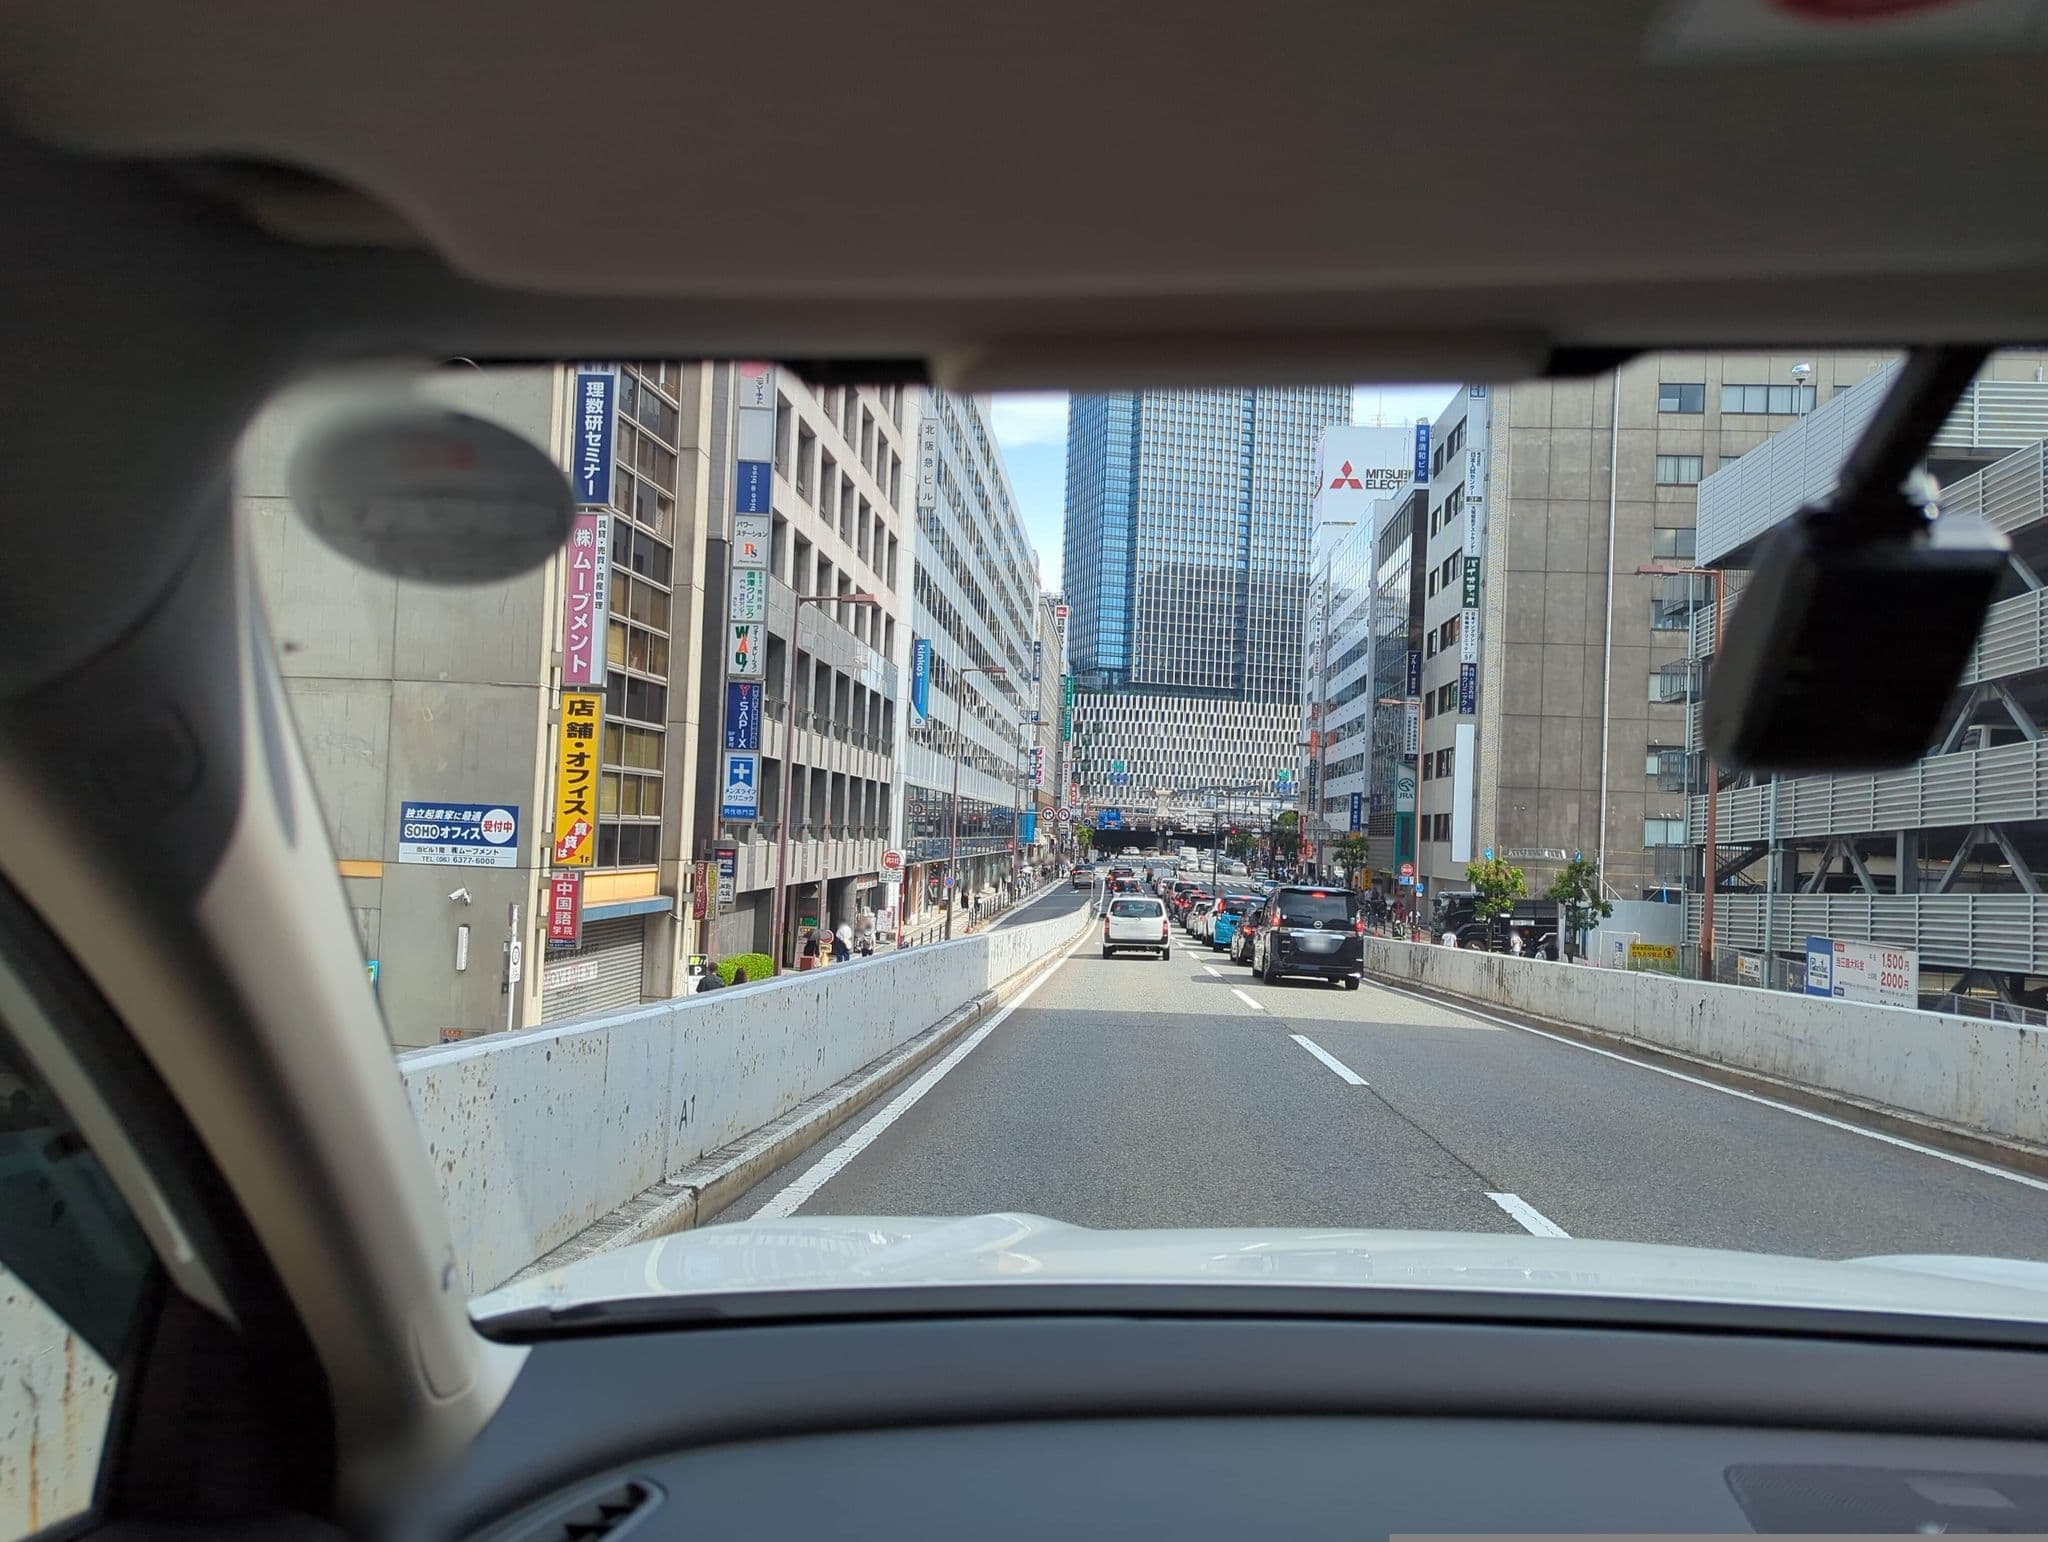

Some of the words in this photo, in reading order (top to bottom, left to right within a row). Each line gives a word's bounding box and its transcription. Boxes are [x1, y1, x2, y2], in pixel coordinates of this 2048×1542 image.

[584, 382, 605, 495] 理数研セミナー
[922, 424, 935, 501] 北阪急ビル
[736, 530, 769, 538] ステーション
[570, 528, 593, 673] (株)ムーブメント
[563, 700, 595, 815] 店舗・オフィス
[405, 824, 481, 840] SOHOオフィス
[483, 820, 513, 833] 受付中
[579, 854, 590, 864] 1F
[555, 882, 573, 926] 中国語
[552, 926, 573, 936] 学院
[695, 967, 702, 975] P
